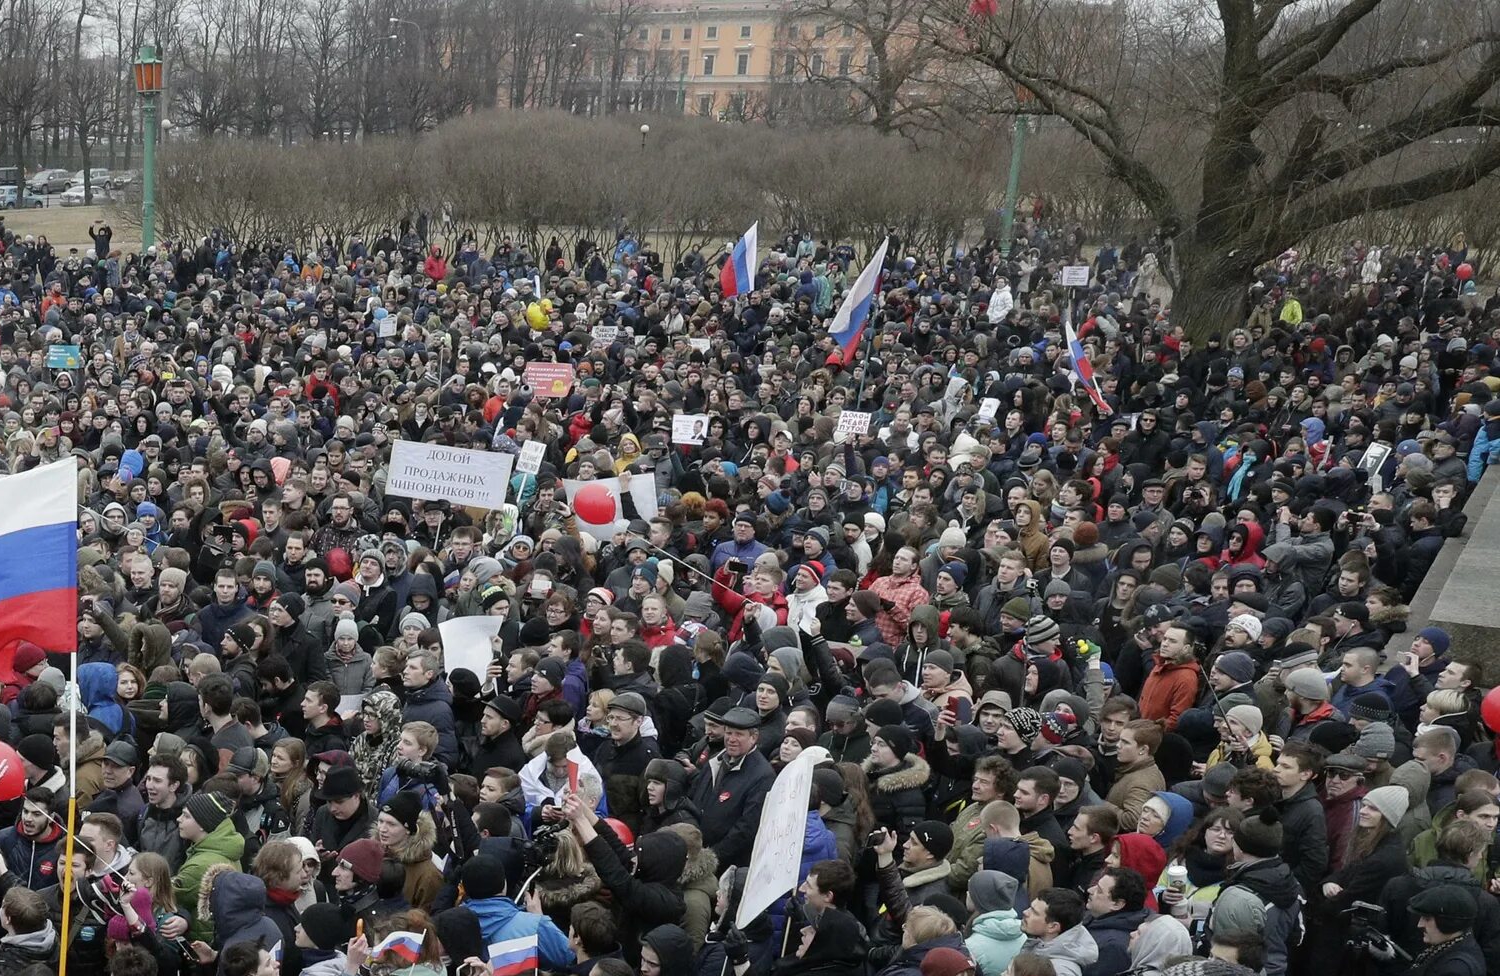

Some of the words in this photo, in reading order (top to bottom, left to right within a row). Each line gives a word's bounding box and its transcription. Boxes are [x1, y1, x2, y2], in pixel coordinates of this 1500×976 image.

[426, 450, 470, 465] ДОЛОЙ
[404, 465, 487, 486] ПРОДАЖНЫХ
[390, 479, 475, 499] ЧИНОВНИКОВ
